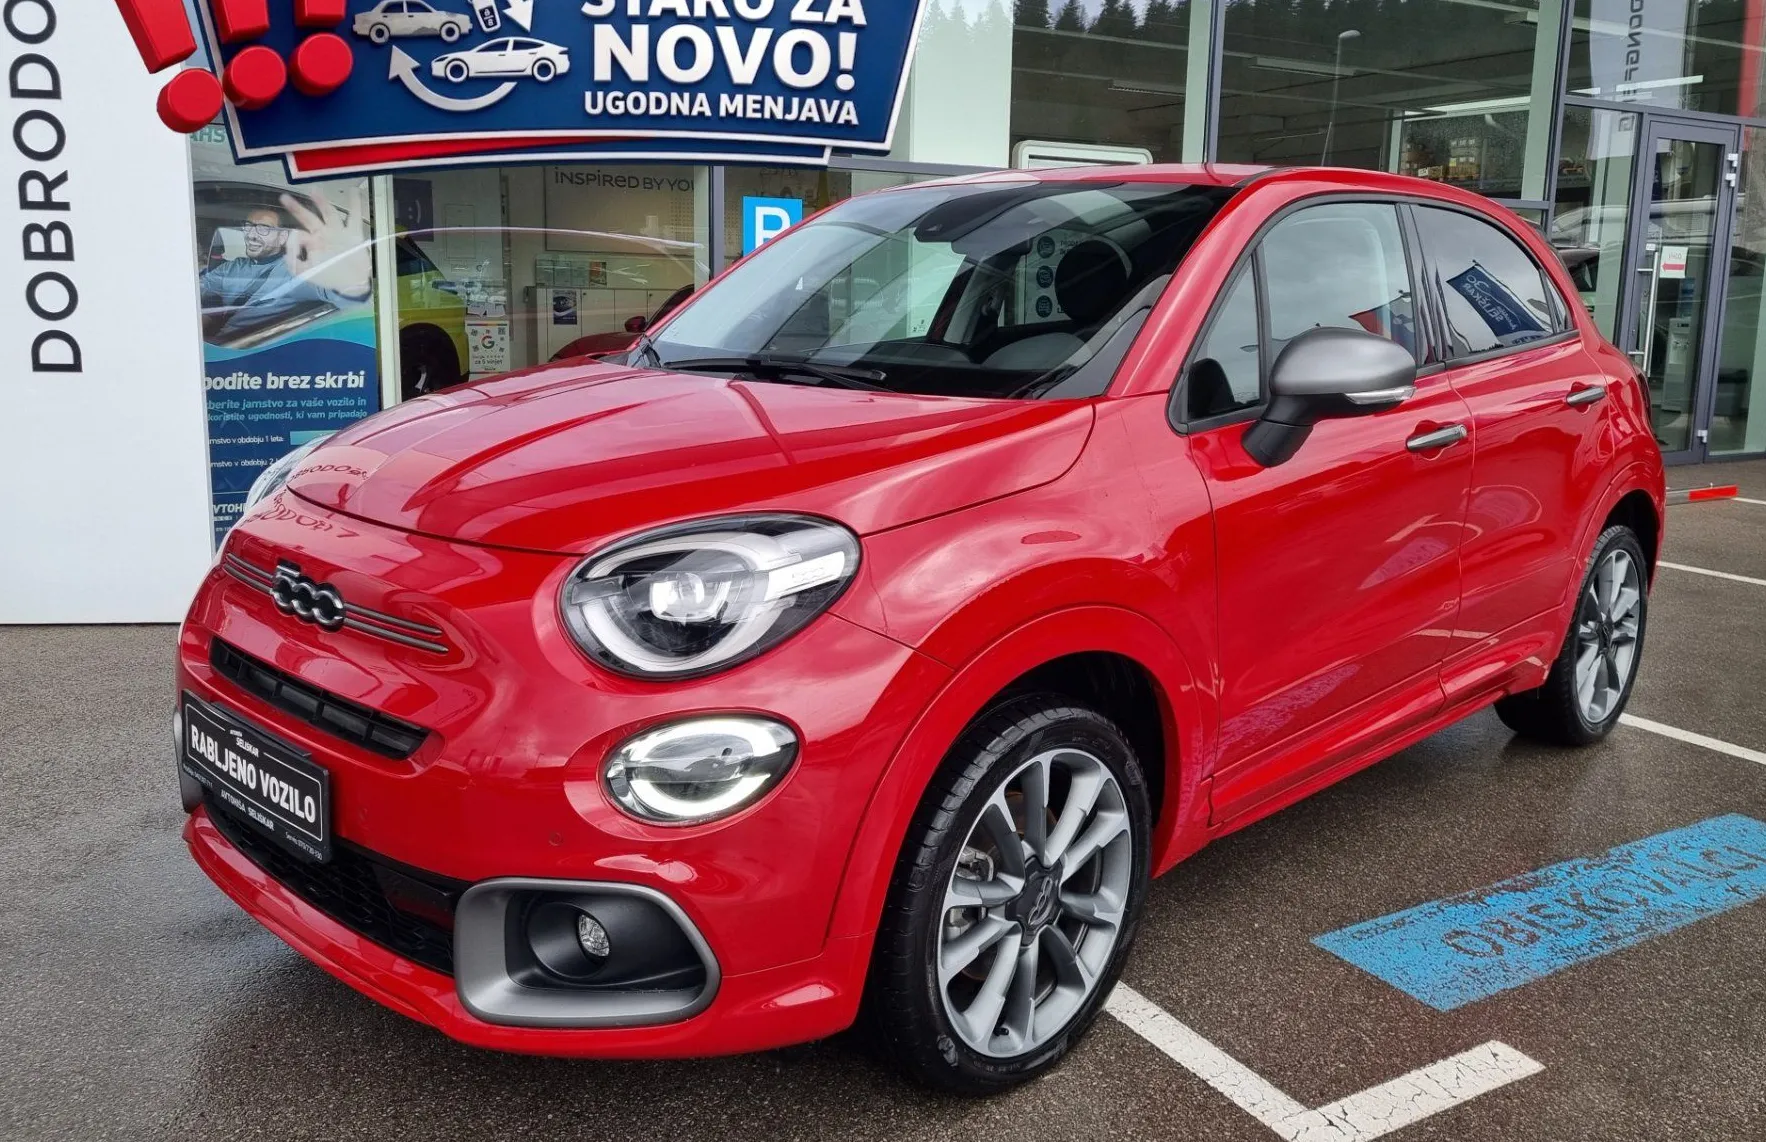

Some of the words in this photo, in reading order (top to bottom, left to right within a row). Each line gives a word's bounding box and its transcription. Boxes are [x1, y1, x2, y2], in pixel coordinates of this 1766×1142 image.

[643, 177, 663, 190] BY
[755, 206, 791, 254] P
[481, 335, 495, 349] G
[266, 372, 311, 390] brez
[314, 370, 365, 389] skrbi
[242, 398, 283, 410] jamstvo
[286, 400, 298, 408] za
[300, 397, 324, 408] vaše
[327, 397, 355, 407] vozilo
[357, 397, 367, 406] in
[248, 411, 293, 423] ugodnosti,
[296, 410, 304, 419] ki
[307, 411, 326, 419] vam
[328, 410, 368, 421] pripadajo
[237, 436, 264, 444] obdobju
[240, 459, 267, 468] obdobju
[273, 563, 344, 625] 500
[191, 724, 257, 790] RABLJENO
[259, 769, 316, 823] VOZILO
